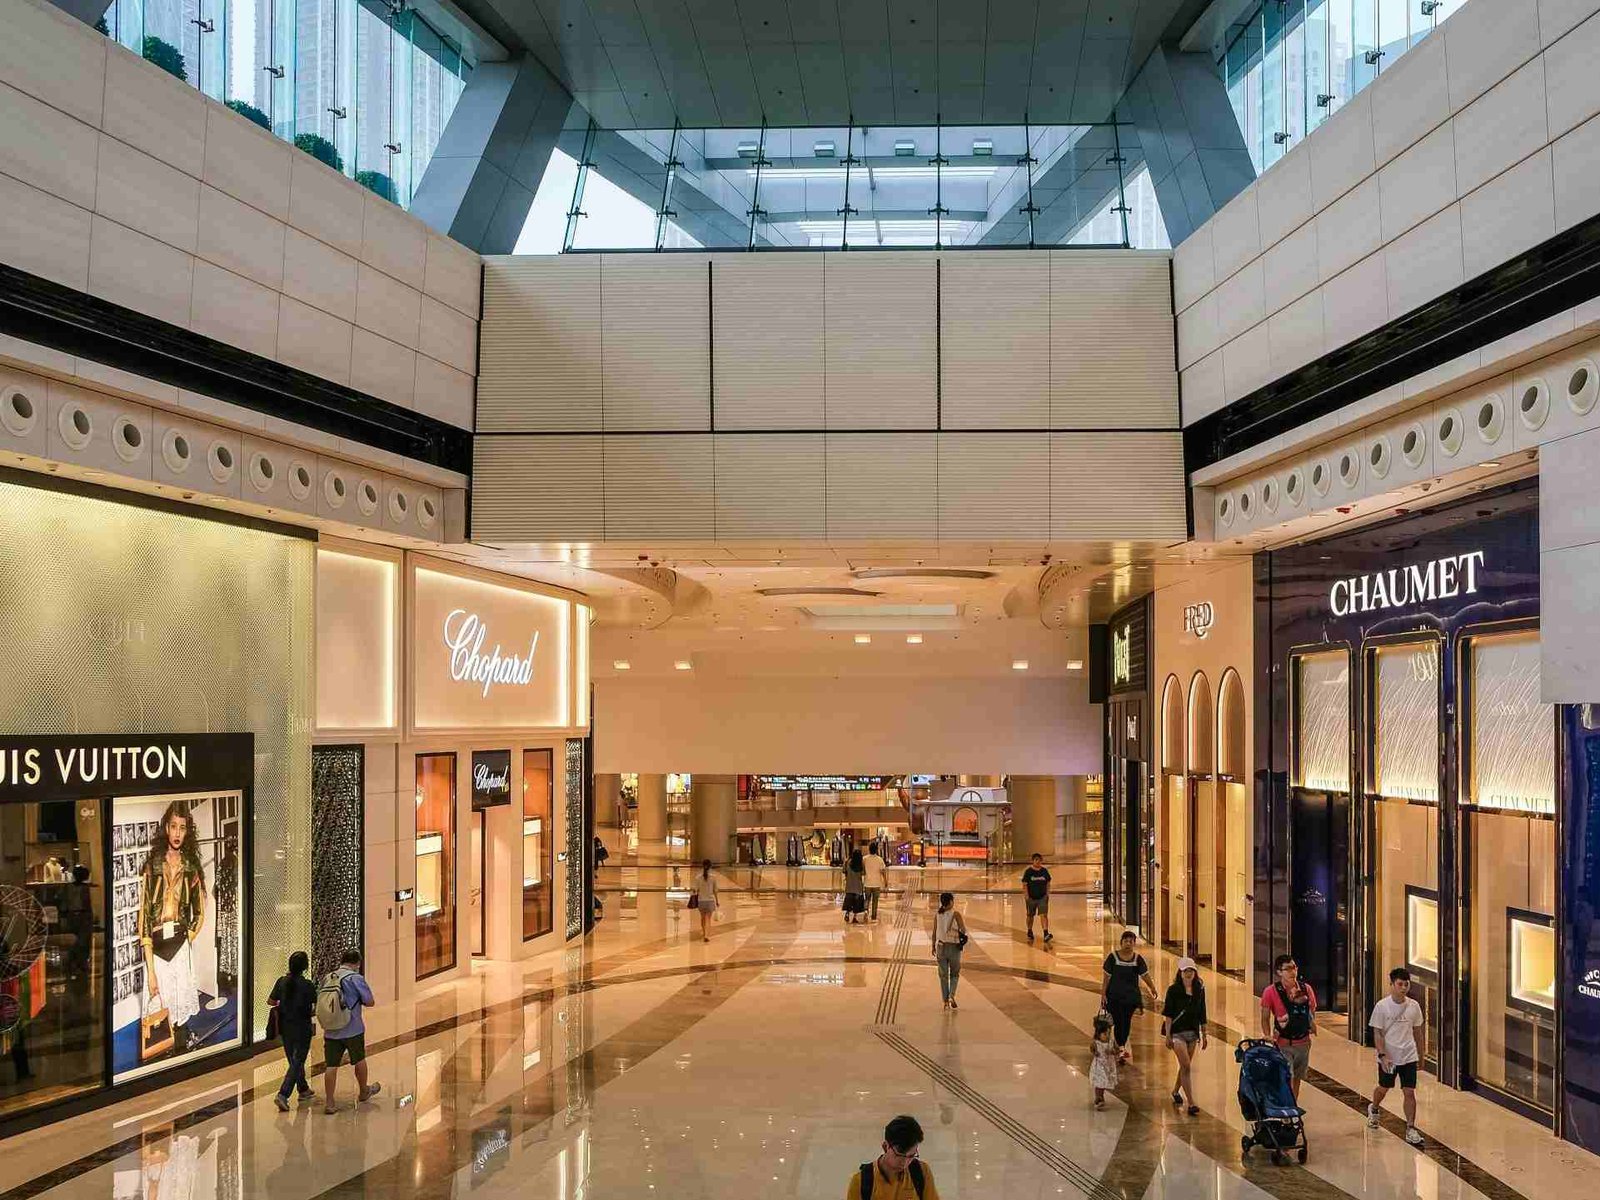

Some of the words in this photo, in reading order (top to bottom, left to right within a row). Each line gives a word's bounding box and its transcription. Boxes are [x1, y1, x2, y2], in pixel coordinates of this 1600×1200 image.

[1329, 550, 1485, 617] CHAUMET
[444, 608, 539, 698] Chopard
[55, 743, 187, 785] VUITTON
[474, 763, 509, 794] Chopard
